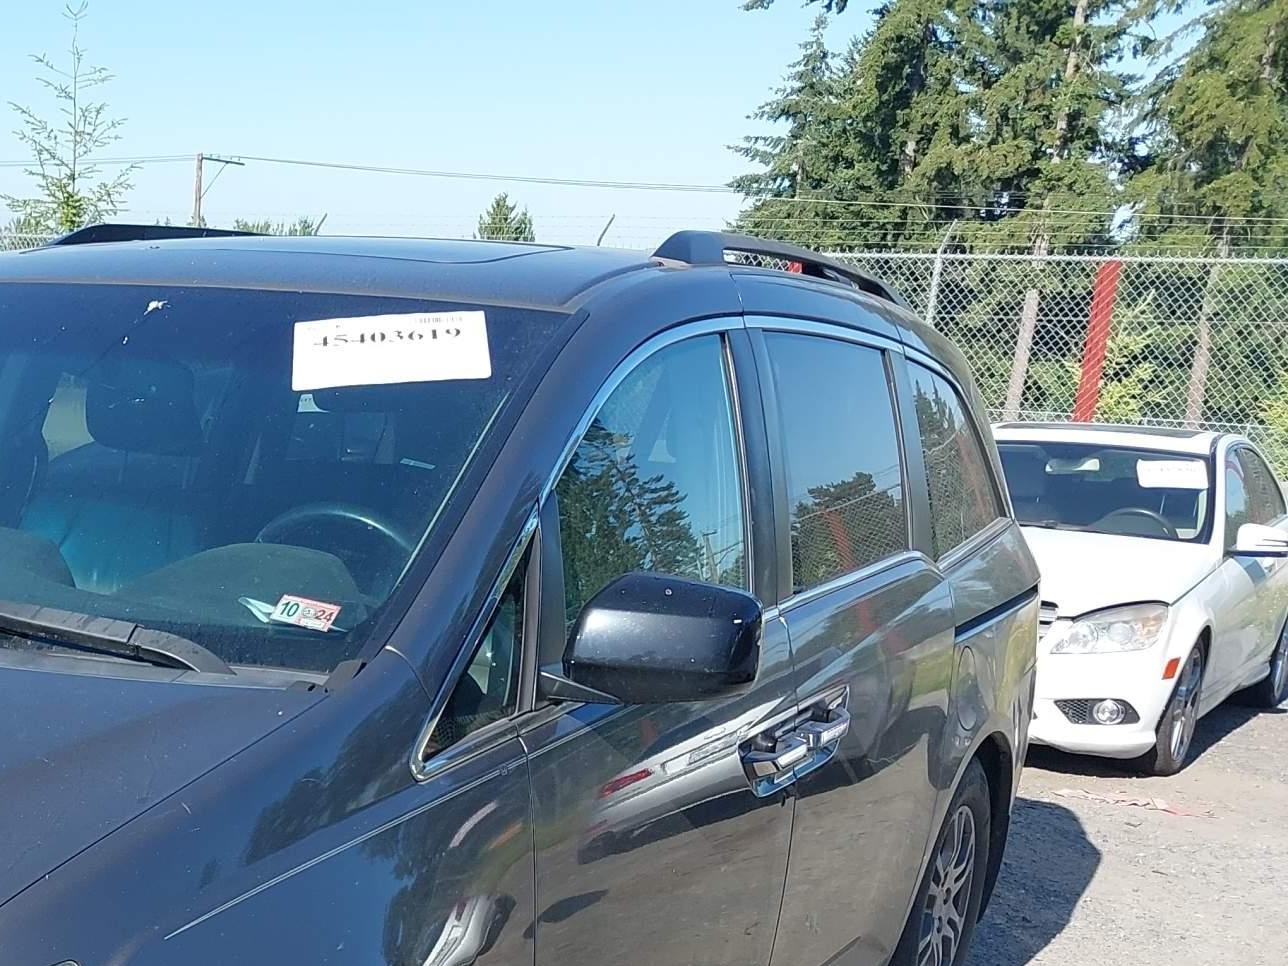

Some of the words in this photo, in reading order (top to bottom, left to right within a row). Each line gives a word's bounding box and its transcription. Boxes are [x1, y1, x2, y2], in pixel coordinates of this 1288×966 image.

[313, 328, 461, 348] 45403619
[279, 601, 300, 618] 10
[314, 609, 334, 623] 24
